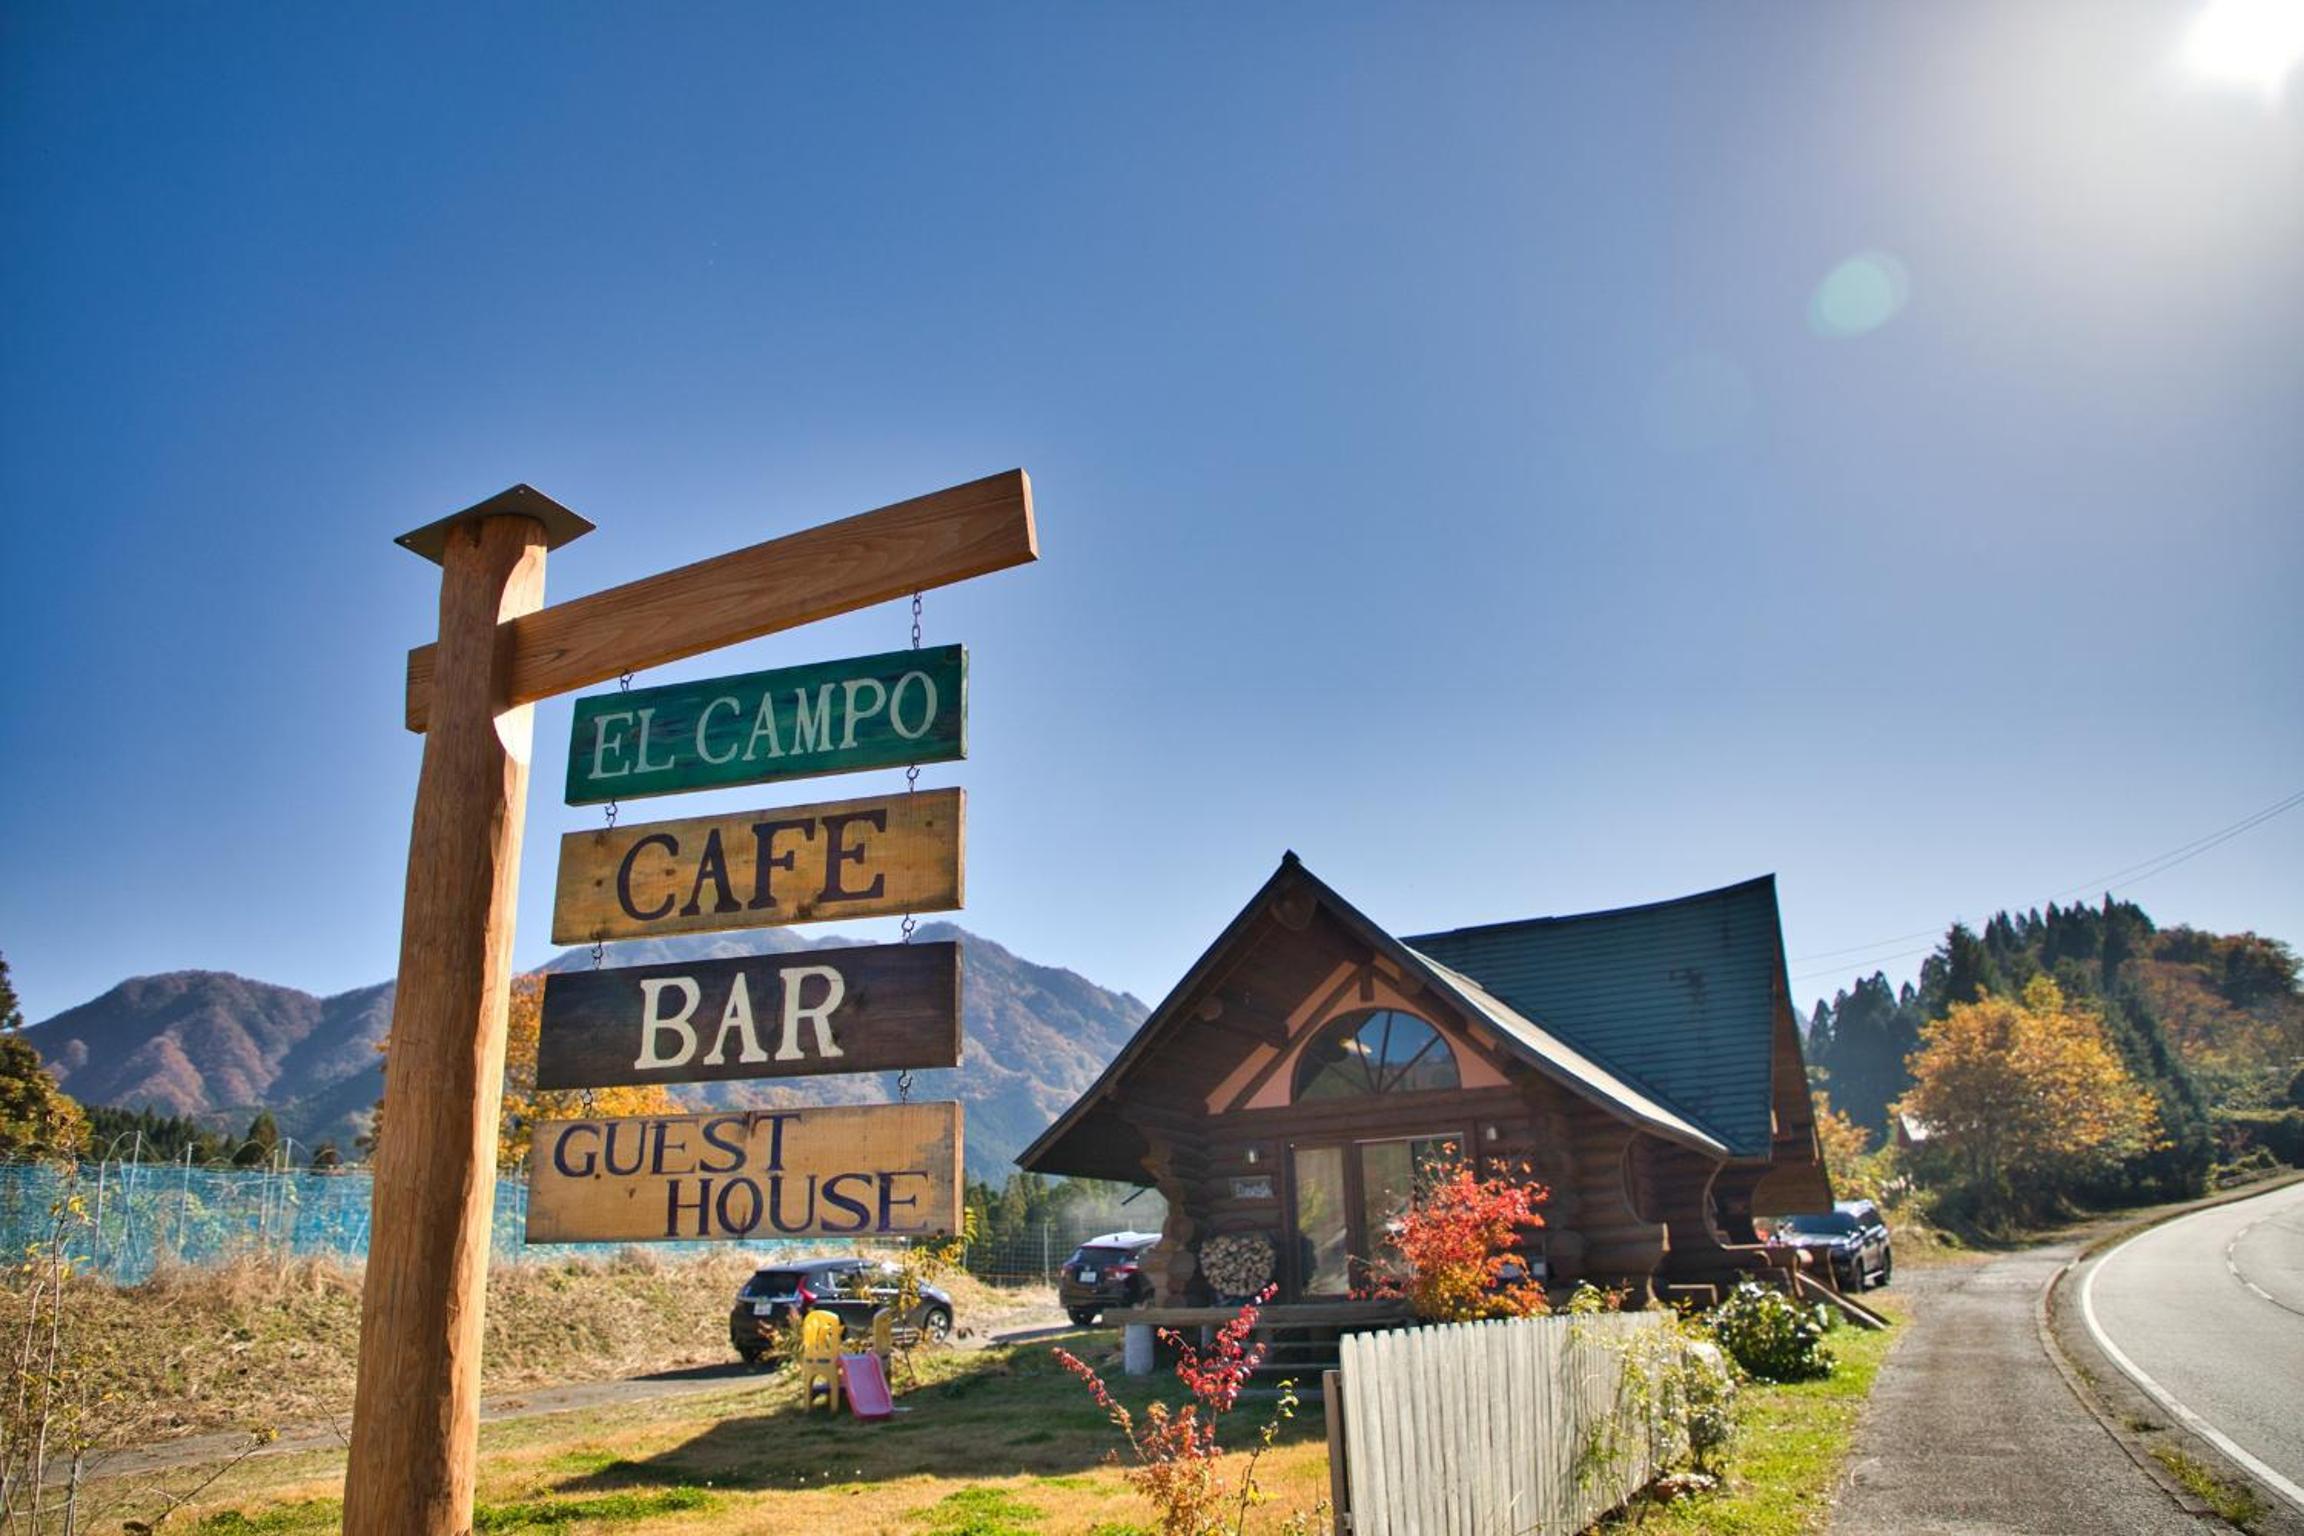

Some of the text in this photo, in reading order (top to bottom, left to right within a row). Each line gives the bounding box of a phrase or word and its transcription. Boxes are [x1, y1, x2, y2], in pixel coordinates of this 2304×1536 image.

[588, 670, 937, 779] EL CAMPO
[617, 808, 887, 921] CAFE
[634, 965, 845, 1070] BAR
[553, 1113, 800, 1177] GUEST
[664, 1170, 929, 1237] HOUSE
